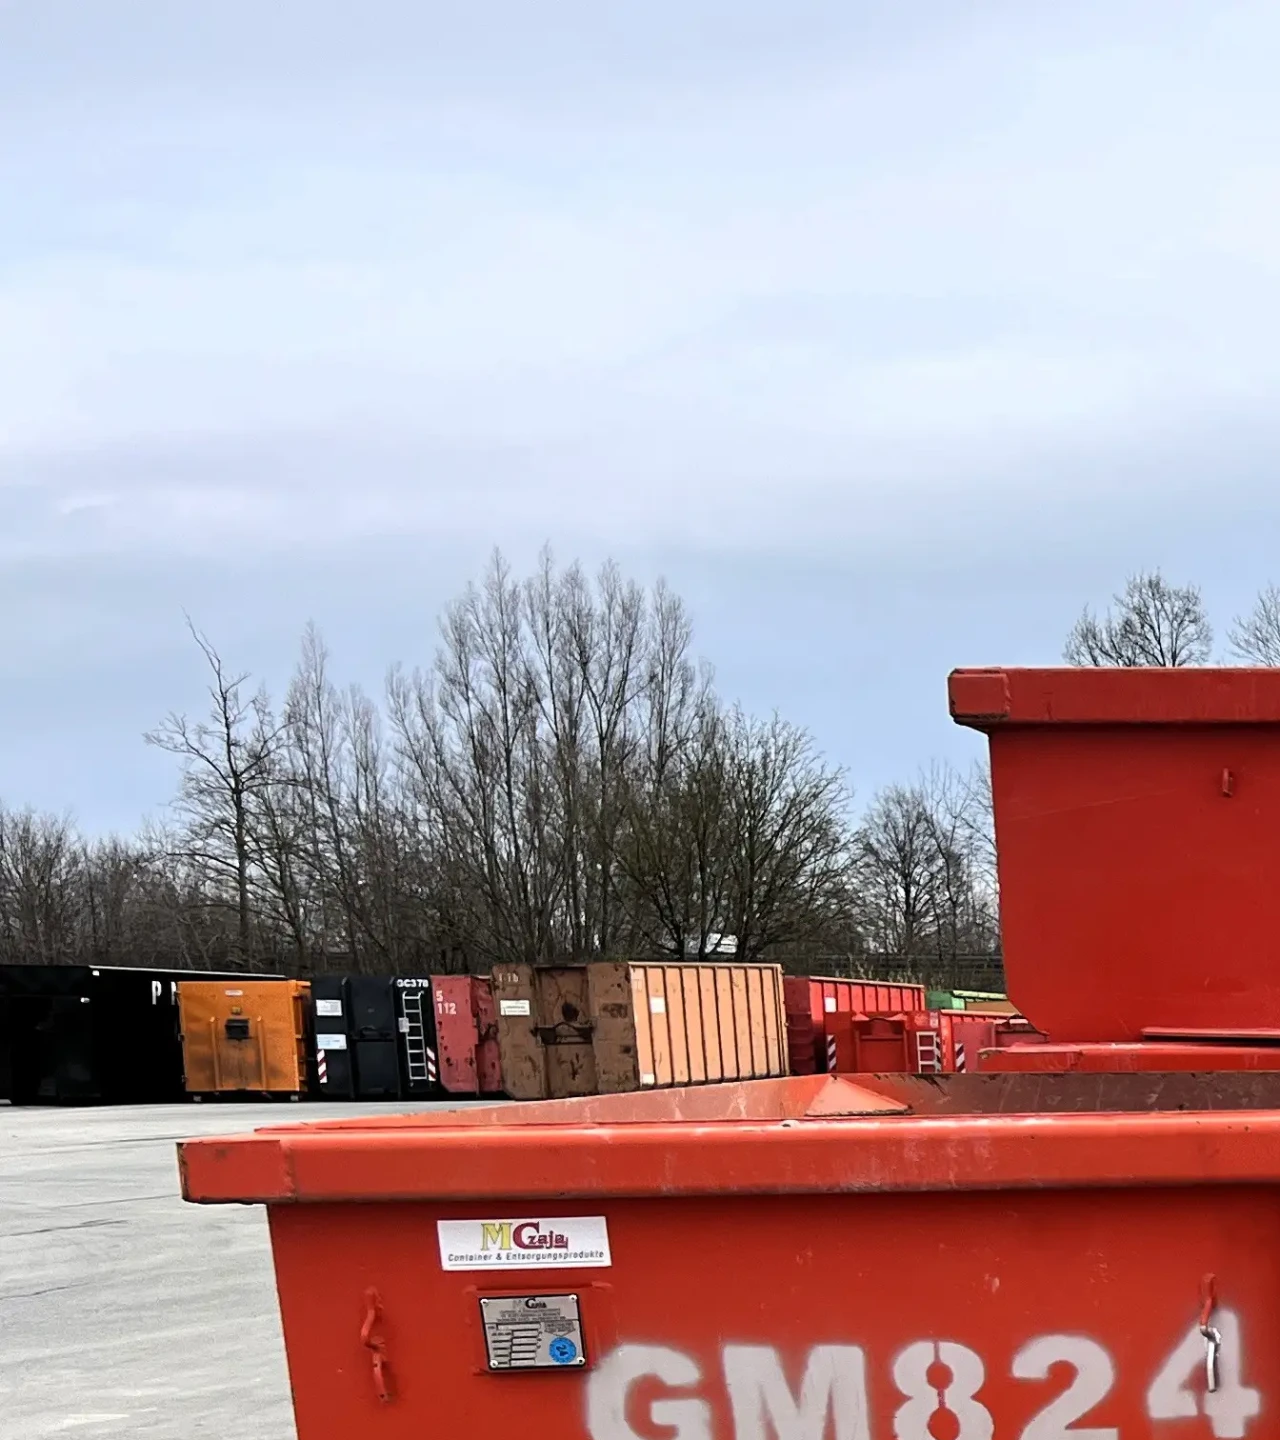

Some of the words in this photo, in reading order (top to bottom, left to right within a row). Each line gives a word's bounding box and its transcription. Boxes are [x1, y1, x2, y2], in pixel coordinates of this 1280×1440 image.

[448, 1253, 493, 1262] Container
[496, 1252, 502, 1260] &
[506, 1251, 604, 1261] Entsorgungsprodukte
